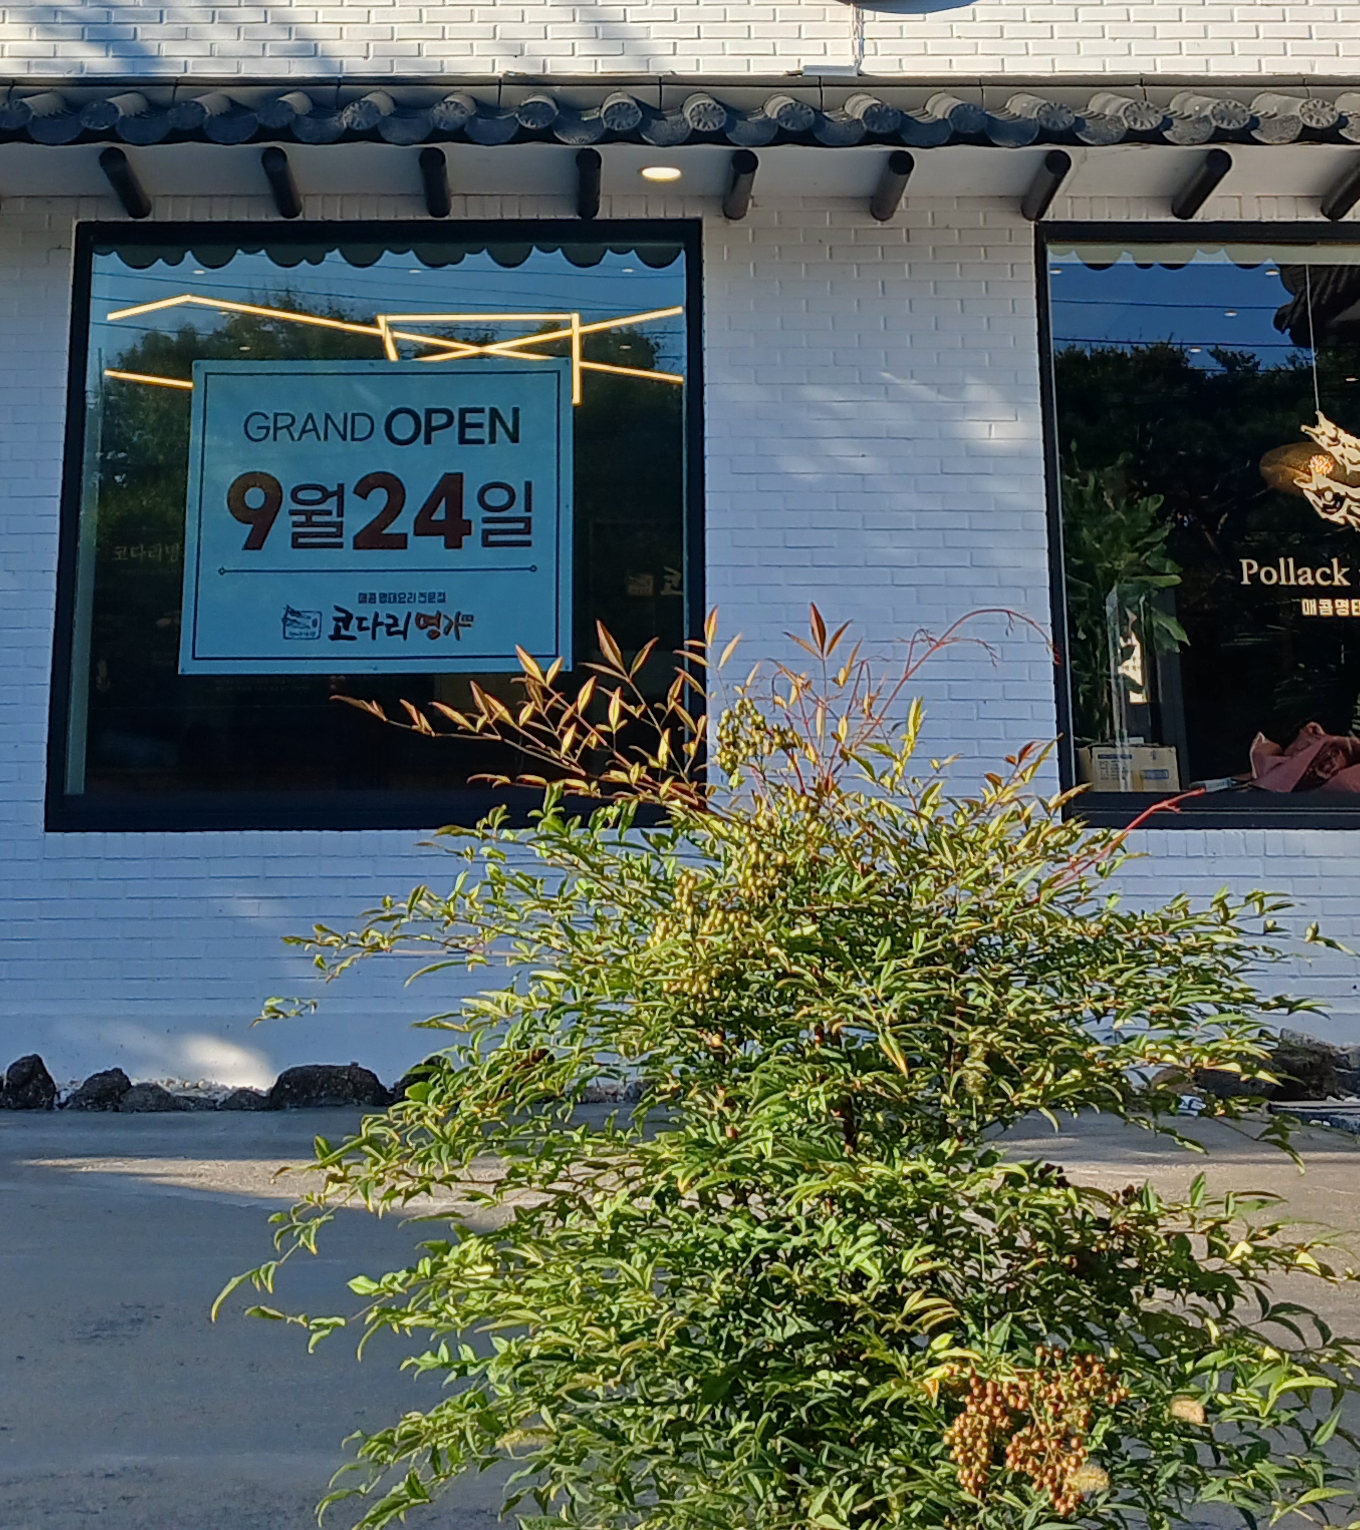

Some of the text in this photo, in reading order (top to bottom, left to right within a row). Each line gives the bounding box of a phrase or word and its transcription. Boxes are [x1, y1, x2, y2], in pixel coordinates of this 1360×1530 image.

[243, 406, 520, 446] GRAND OPEN
[1239, 556, 1351, 586] Pollack
